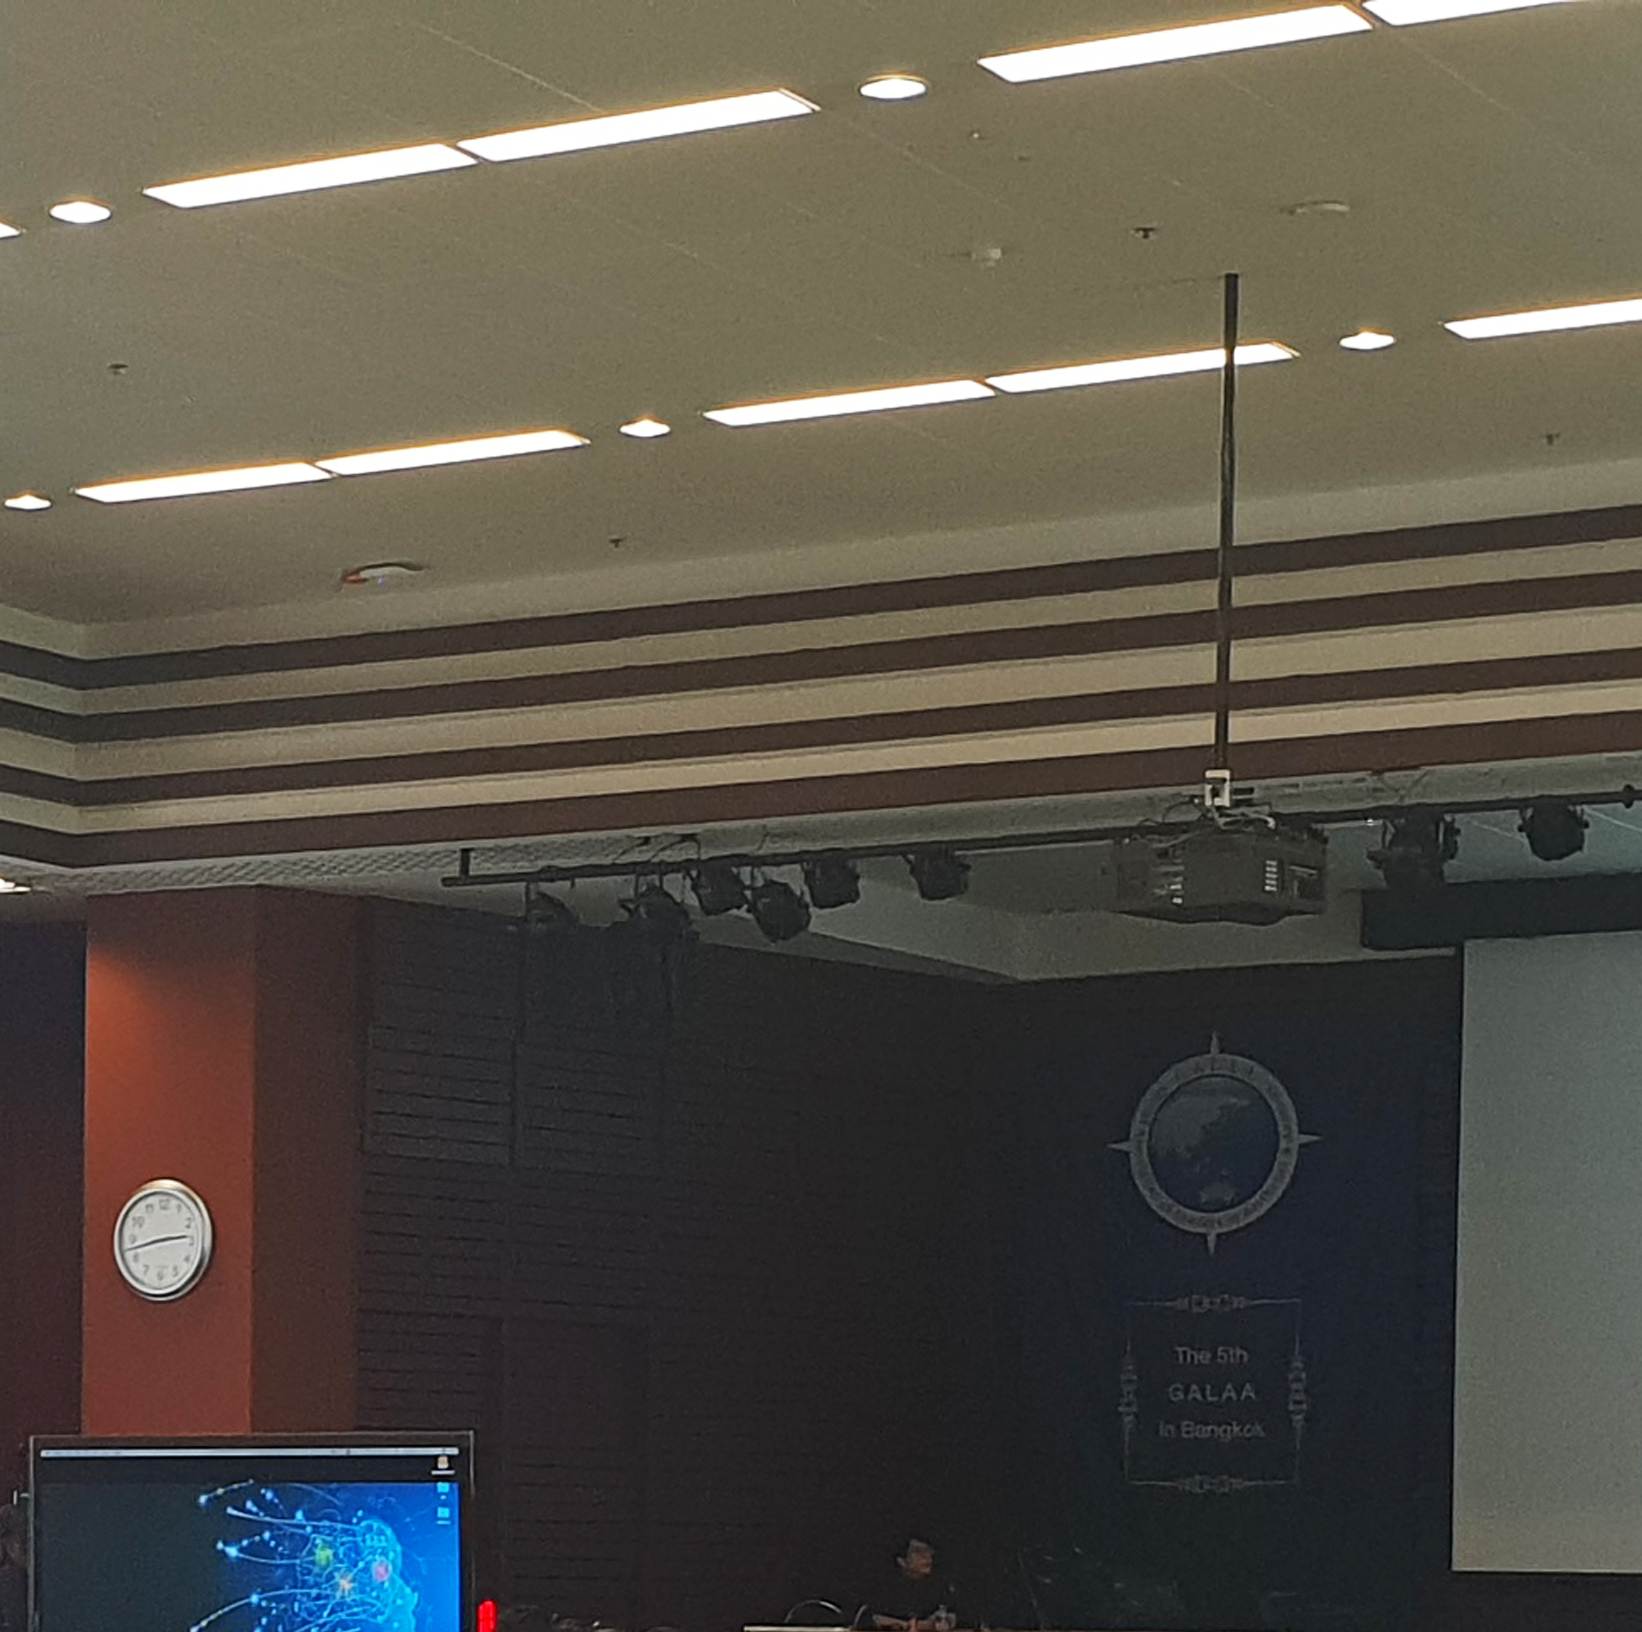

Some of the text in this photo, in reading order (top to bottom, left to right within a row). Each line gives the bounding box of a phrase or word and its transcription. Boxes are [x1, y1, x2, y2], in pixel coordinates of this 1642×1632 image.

[1174, 1346, 1250, 1365] The 5th
[1168, 1382, 1256, 1402] GALAA
[1180, 1420, 1265, 1442] Bangkok
